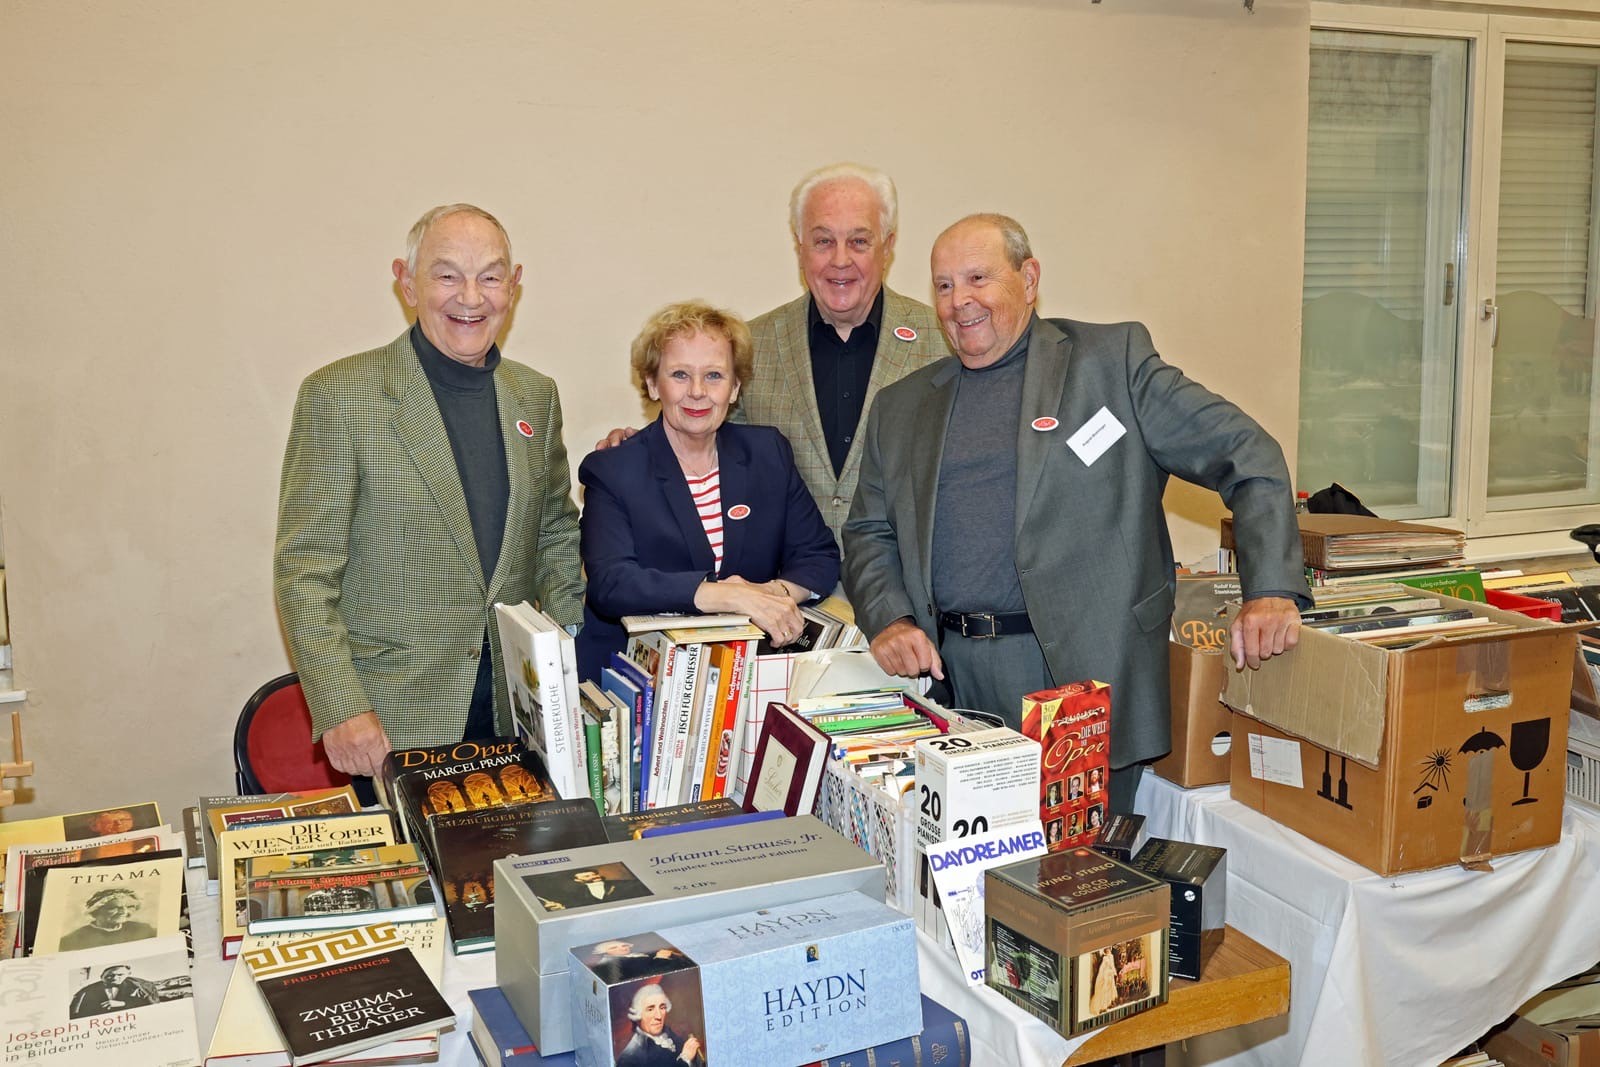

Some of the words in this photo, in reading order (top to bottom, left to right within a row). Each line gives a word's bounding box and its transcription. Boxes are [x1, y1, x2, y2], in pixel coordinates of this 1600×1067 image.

[1181, 620, 1226, 650] Ric
[666, 646, 677, 677] BACKEN
[678, 706, 687, 734] FISCH
[684, 646, 698, 692] GENIESSER
[658, 700, 669, 738] Weihnachten
[1091, 720, 1107, 735] WELT
[395, 749, 448, 768] Die
[451, 742, 519, 762] Oper
[930, 738, 972, 751] 20
[945, 746, 981, 755] GROSSE
[983, 738, 1030, 749] PIANISTEN
[1044, 731, 1105, 774] Oper
[424, 761, 480, 781] MARCEL
[480, 753, 522, 769] PRAWY
[620, 810, 678, 823] Francisco
[697, 801, 731, 812] Goya
[921, 784, 941, 822] 20
[291, 822, 328, 836] DIE
[437, 813, 516, 829] SALZBURGER
[920, 816, 941, 838] GROSSE
[232, 834, 326, 851] WIENER
[329, 826, 385, 841] OPER
[267, 846, 288, 854] Jahre
[338, 838, 369, 847] Tradition
[649, 848, 720, 868] Johann
[722, 837, 797, 855] Strauss,
[799, 833, 823, 844] Jr.
[930, 831, 1045, 872] DAYDREAMER
[655, 862, 708, 876] Complete
[710, 853, 767, 867] Orchestral
[768, 847, 808, 858] Edition
[71, 868, 161, 884] TITAMA
[1032, 873, 1073, 890] LIVING
[1075, 862, 1116, 879] STEREO
[1072, 878, 1128, 898] COLLECTION
[1093, 878, 1110, 887] CD
[728, 909, 832, 936] HAYDN
[737, 914, 838, 940] EDITION
[283, 972, 319, 986] FRED
[320, 957, 390, 979] HENNINGS
[299, 988, 413, 1022] ZWEIMAL
[763, 968, 867, 1017] HAYDN
[309, 1006, 426, 1043] THEATER
[329, 1001, 395, 1027] BURG
[766, 995, 867, 1032] EDITION
[5, 1023, 79, 1045] Joseph
[89, 1012, 137, 1029] Roth
[5, 1038, 53, 1053] Leben
[61, 1031, 90, 1044] und
[97, 1023, 137, 1036] Werk
[5, 1054, 20, 1063] in
[28, 1042, 84, 1059] Bildern
